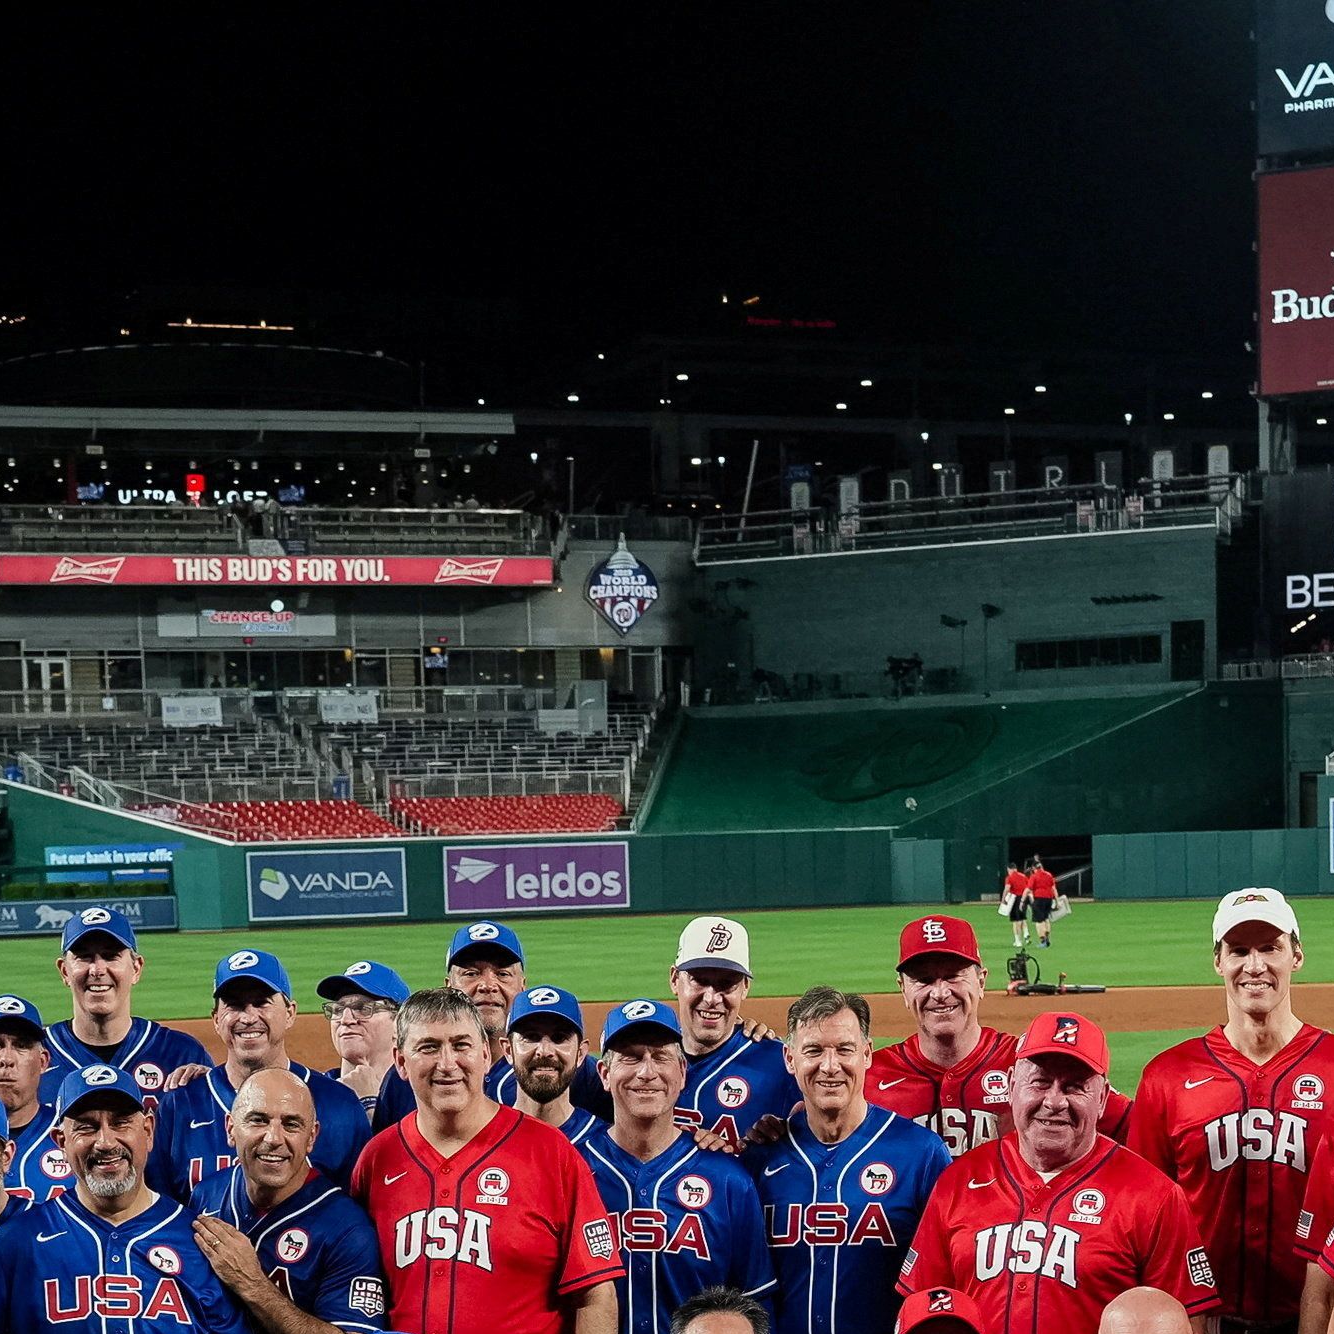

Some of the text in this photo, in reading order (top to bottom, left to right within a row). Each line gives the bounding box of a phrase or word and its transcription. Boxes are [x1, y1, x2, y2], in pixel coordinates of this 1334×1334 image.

[172, 558, 390, 582] THIS BUD'S FOR YOU.
[599, 574, 648, 586] WORLD
[589, 585, 658, 600] CHAMPIONS
[210, 611, 295, 623] CHANGE-UP
[50, 853, 67, 865] Put
[68, 854, 86, 865] our
[86, 850, 112, 864] bank
[113, 850, 124, 863] in
[124, 852, 148, 864] your
[290, 871, 394, 892] VANDA
[505, 862, 622, 900] leidos
[1204, 1106, 1308, 1175] USA
[477, 1195, 507, 1205] 6-14-17
[763, 1202, 898, 1248] USA
[395, 1206, 494, 1273] USA
[974, 1221, 1082, 1290] USA
[355, 1280, 384, 1293] USA
[43, 1273, 193, 1326] USA
[352, 1295, 384, 1311] 250
